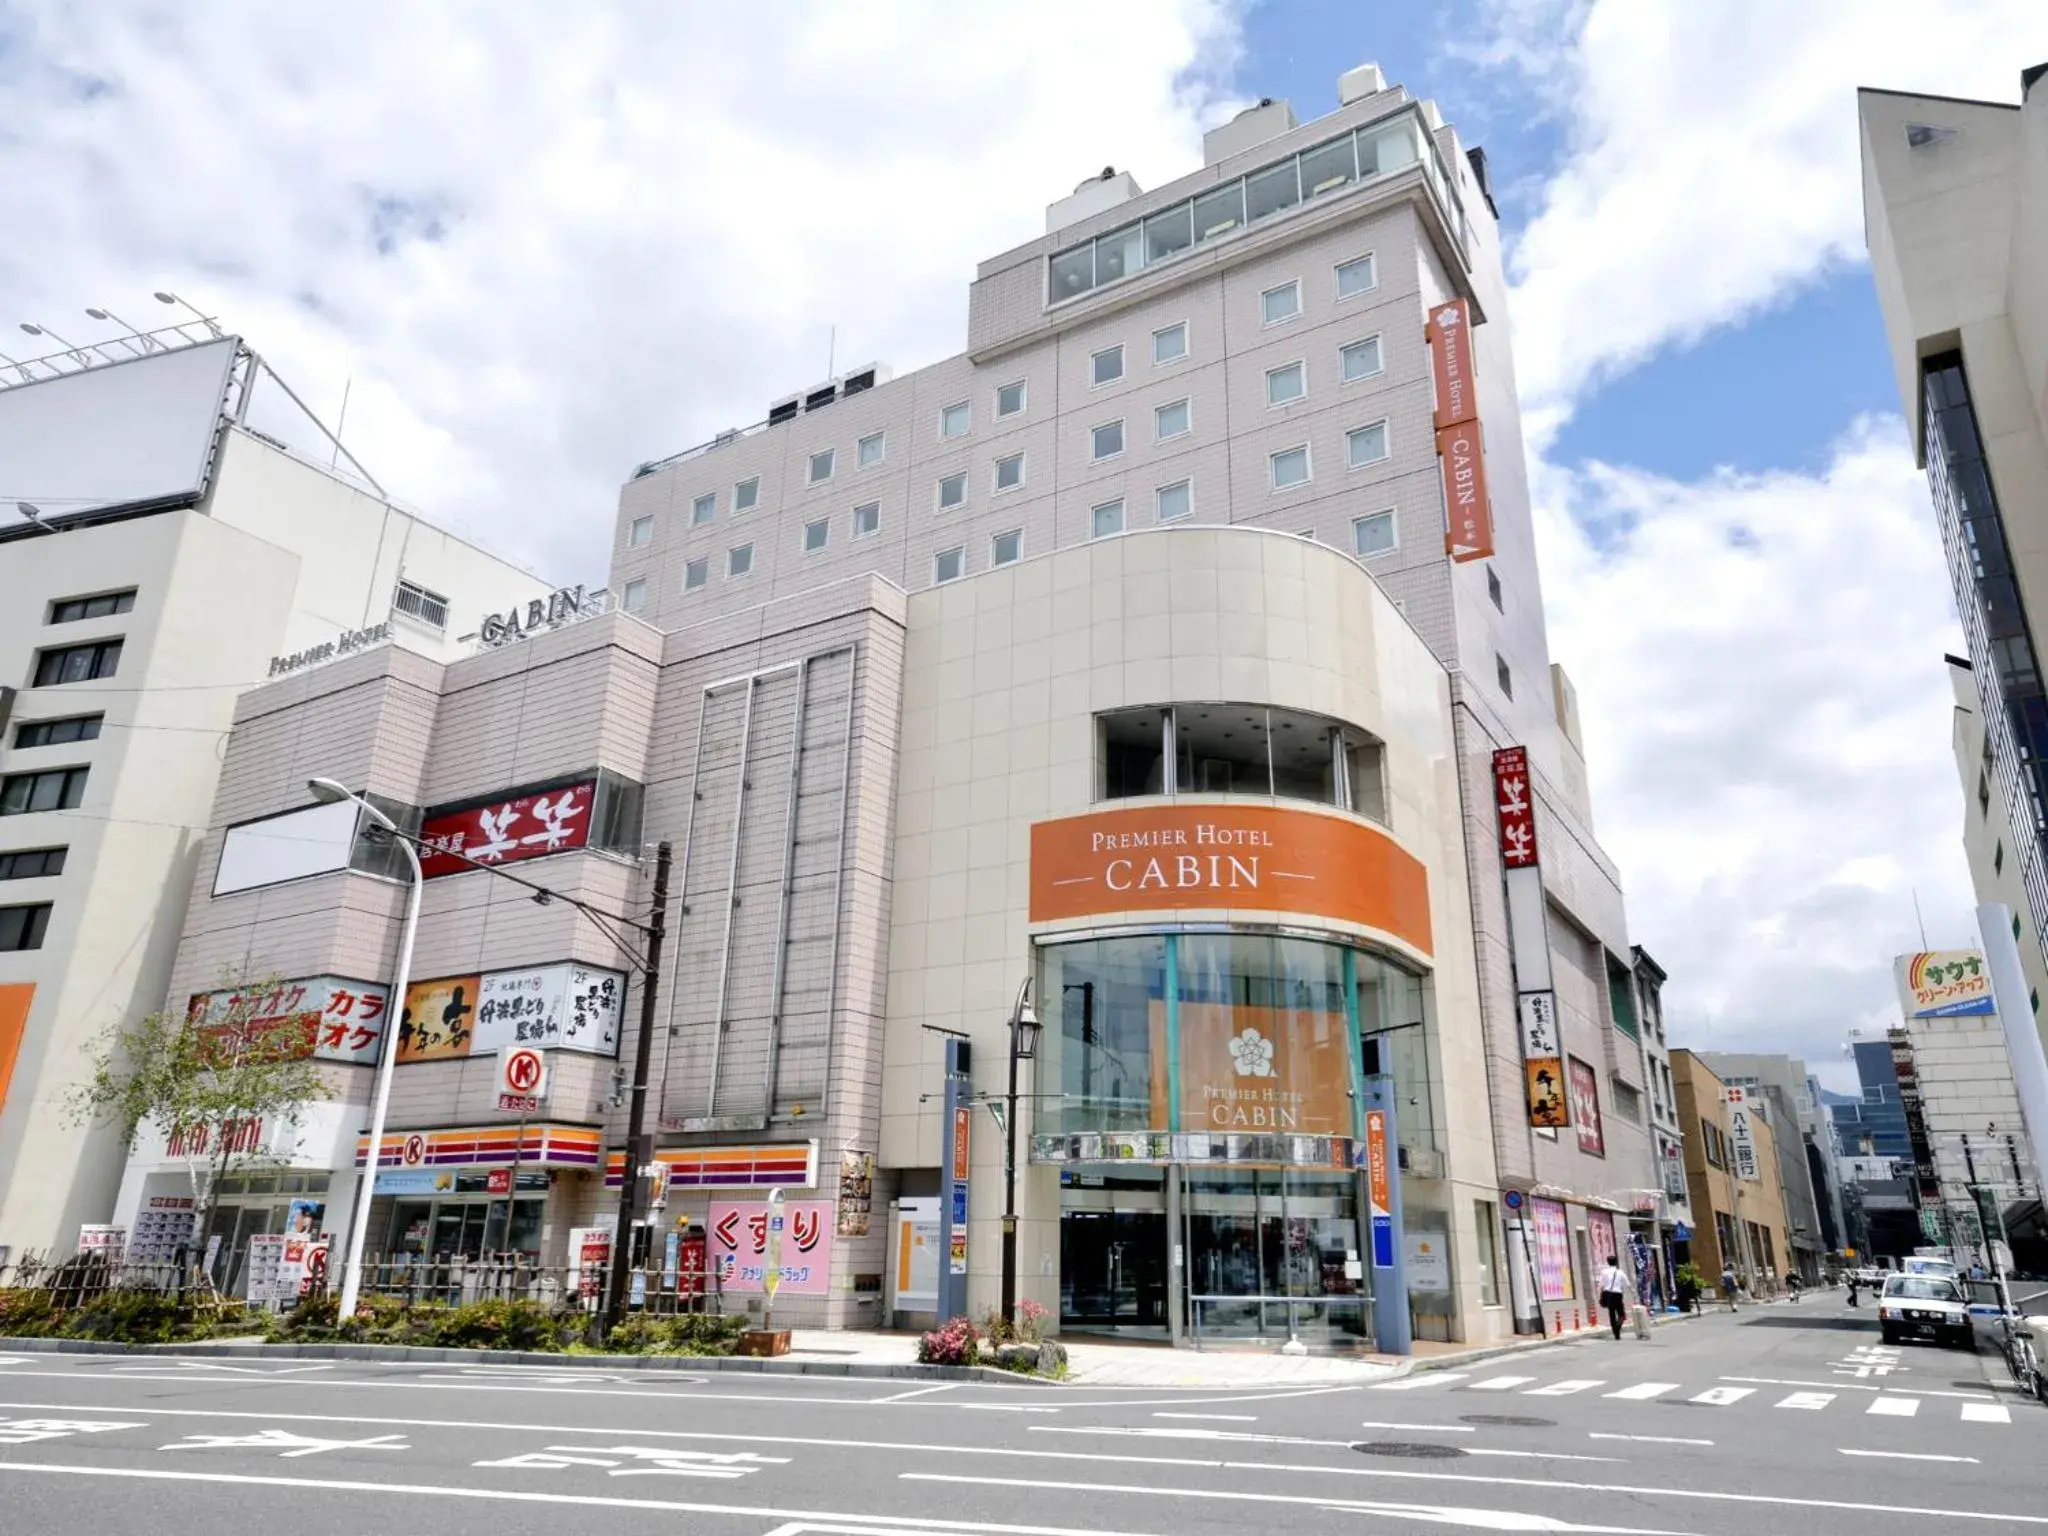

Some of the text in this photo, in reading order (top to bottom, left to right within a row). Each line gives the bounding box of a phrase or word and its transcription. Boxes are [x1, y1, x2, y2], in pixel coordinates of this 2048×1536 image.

[1452, 439, 1476, 505] CABIN
[481, 584, 584, 646] CABIN
[464, 790, 585, 861] 笑笑
[1092, 824, 1273, 852] PREMIER HOTEL
[1105, 855, 1260, 891] CABIN
[483, 978, 496, 993] 2F
[574, 971, 588, 985] 2F
[1924, 956, 1982, 986] サウナ
[325, 989, 385, 1019] カラ
[322, 1022, 378, 1051] オケ
[1213, 1104, 1297, 1129] CABIN
[1733, 1112, 1755, 1176] 八十二銀行
